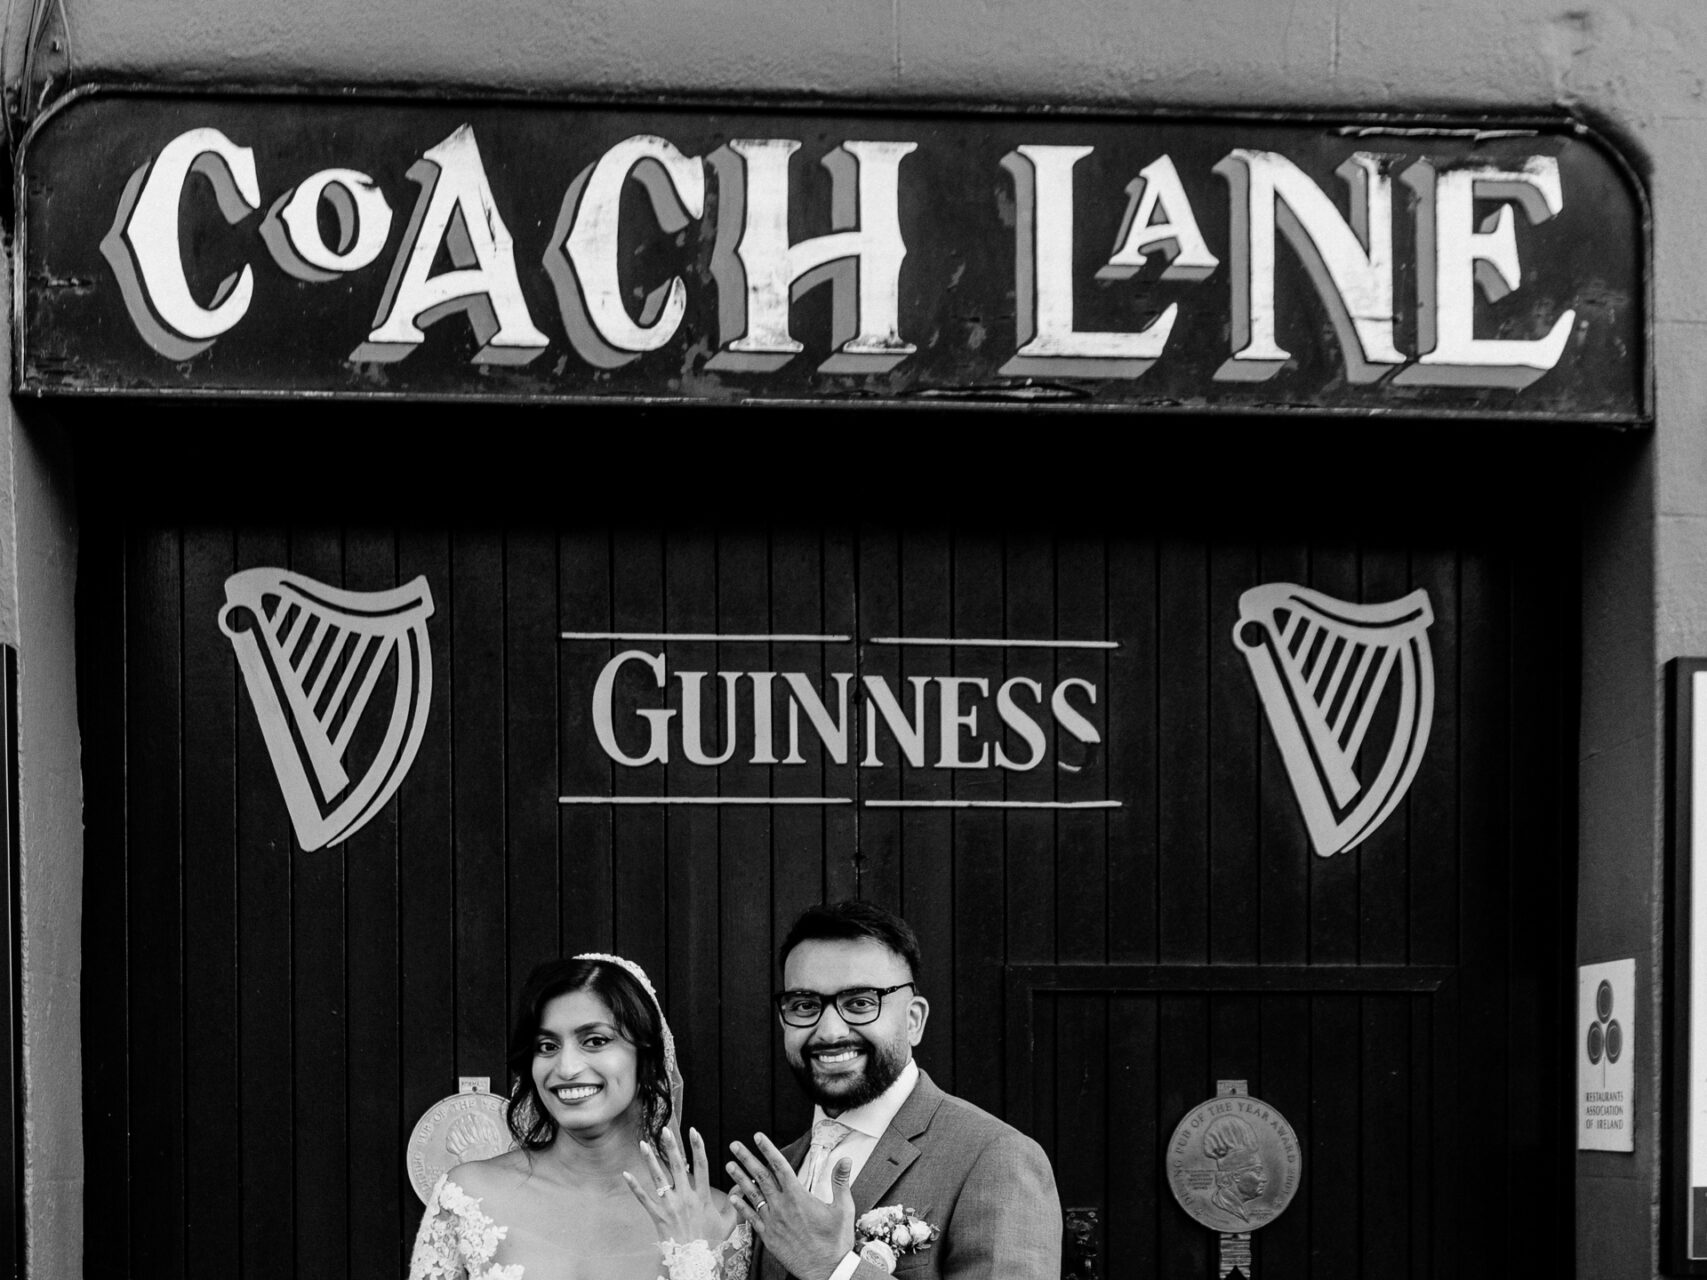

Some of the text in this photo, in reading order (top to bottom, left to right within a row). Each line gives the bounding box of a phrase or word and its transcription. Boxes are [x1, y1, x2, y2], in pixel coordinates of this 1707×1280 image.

[1001, 145, 1576, 384] LANE
[591, 649, 1102, 772] GUINNESS
[1585, 1090, 1624, 1102] RESTAURANTS
[1585, 1104, 1624, 1116] ASSOCIATION
[1190, 1111, 1205, 1129] OF
[1207, 1101, 1233, 1117] THE
[1237, 1101, 1270, 1122] YEAR
[1269, 1119, 1297, 1164] AWARD
[1585, 1118, 1624, 1130] OF IRELAND
